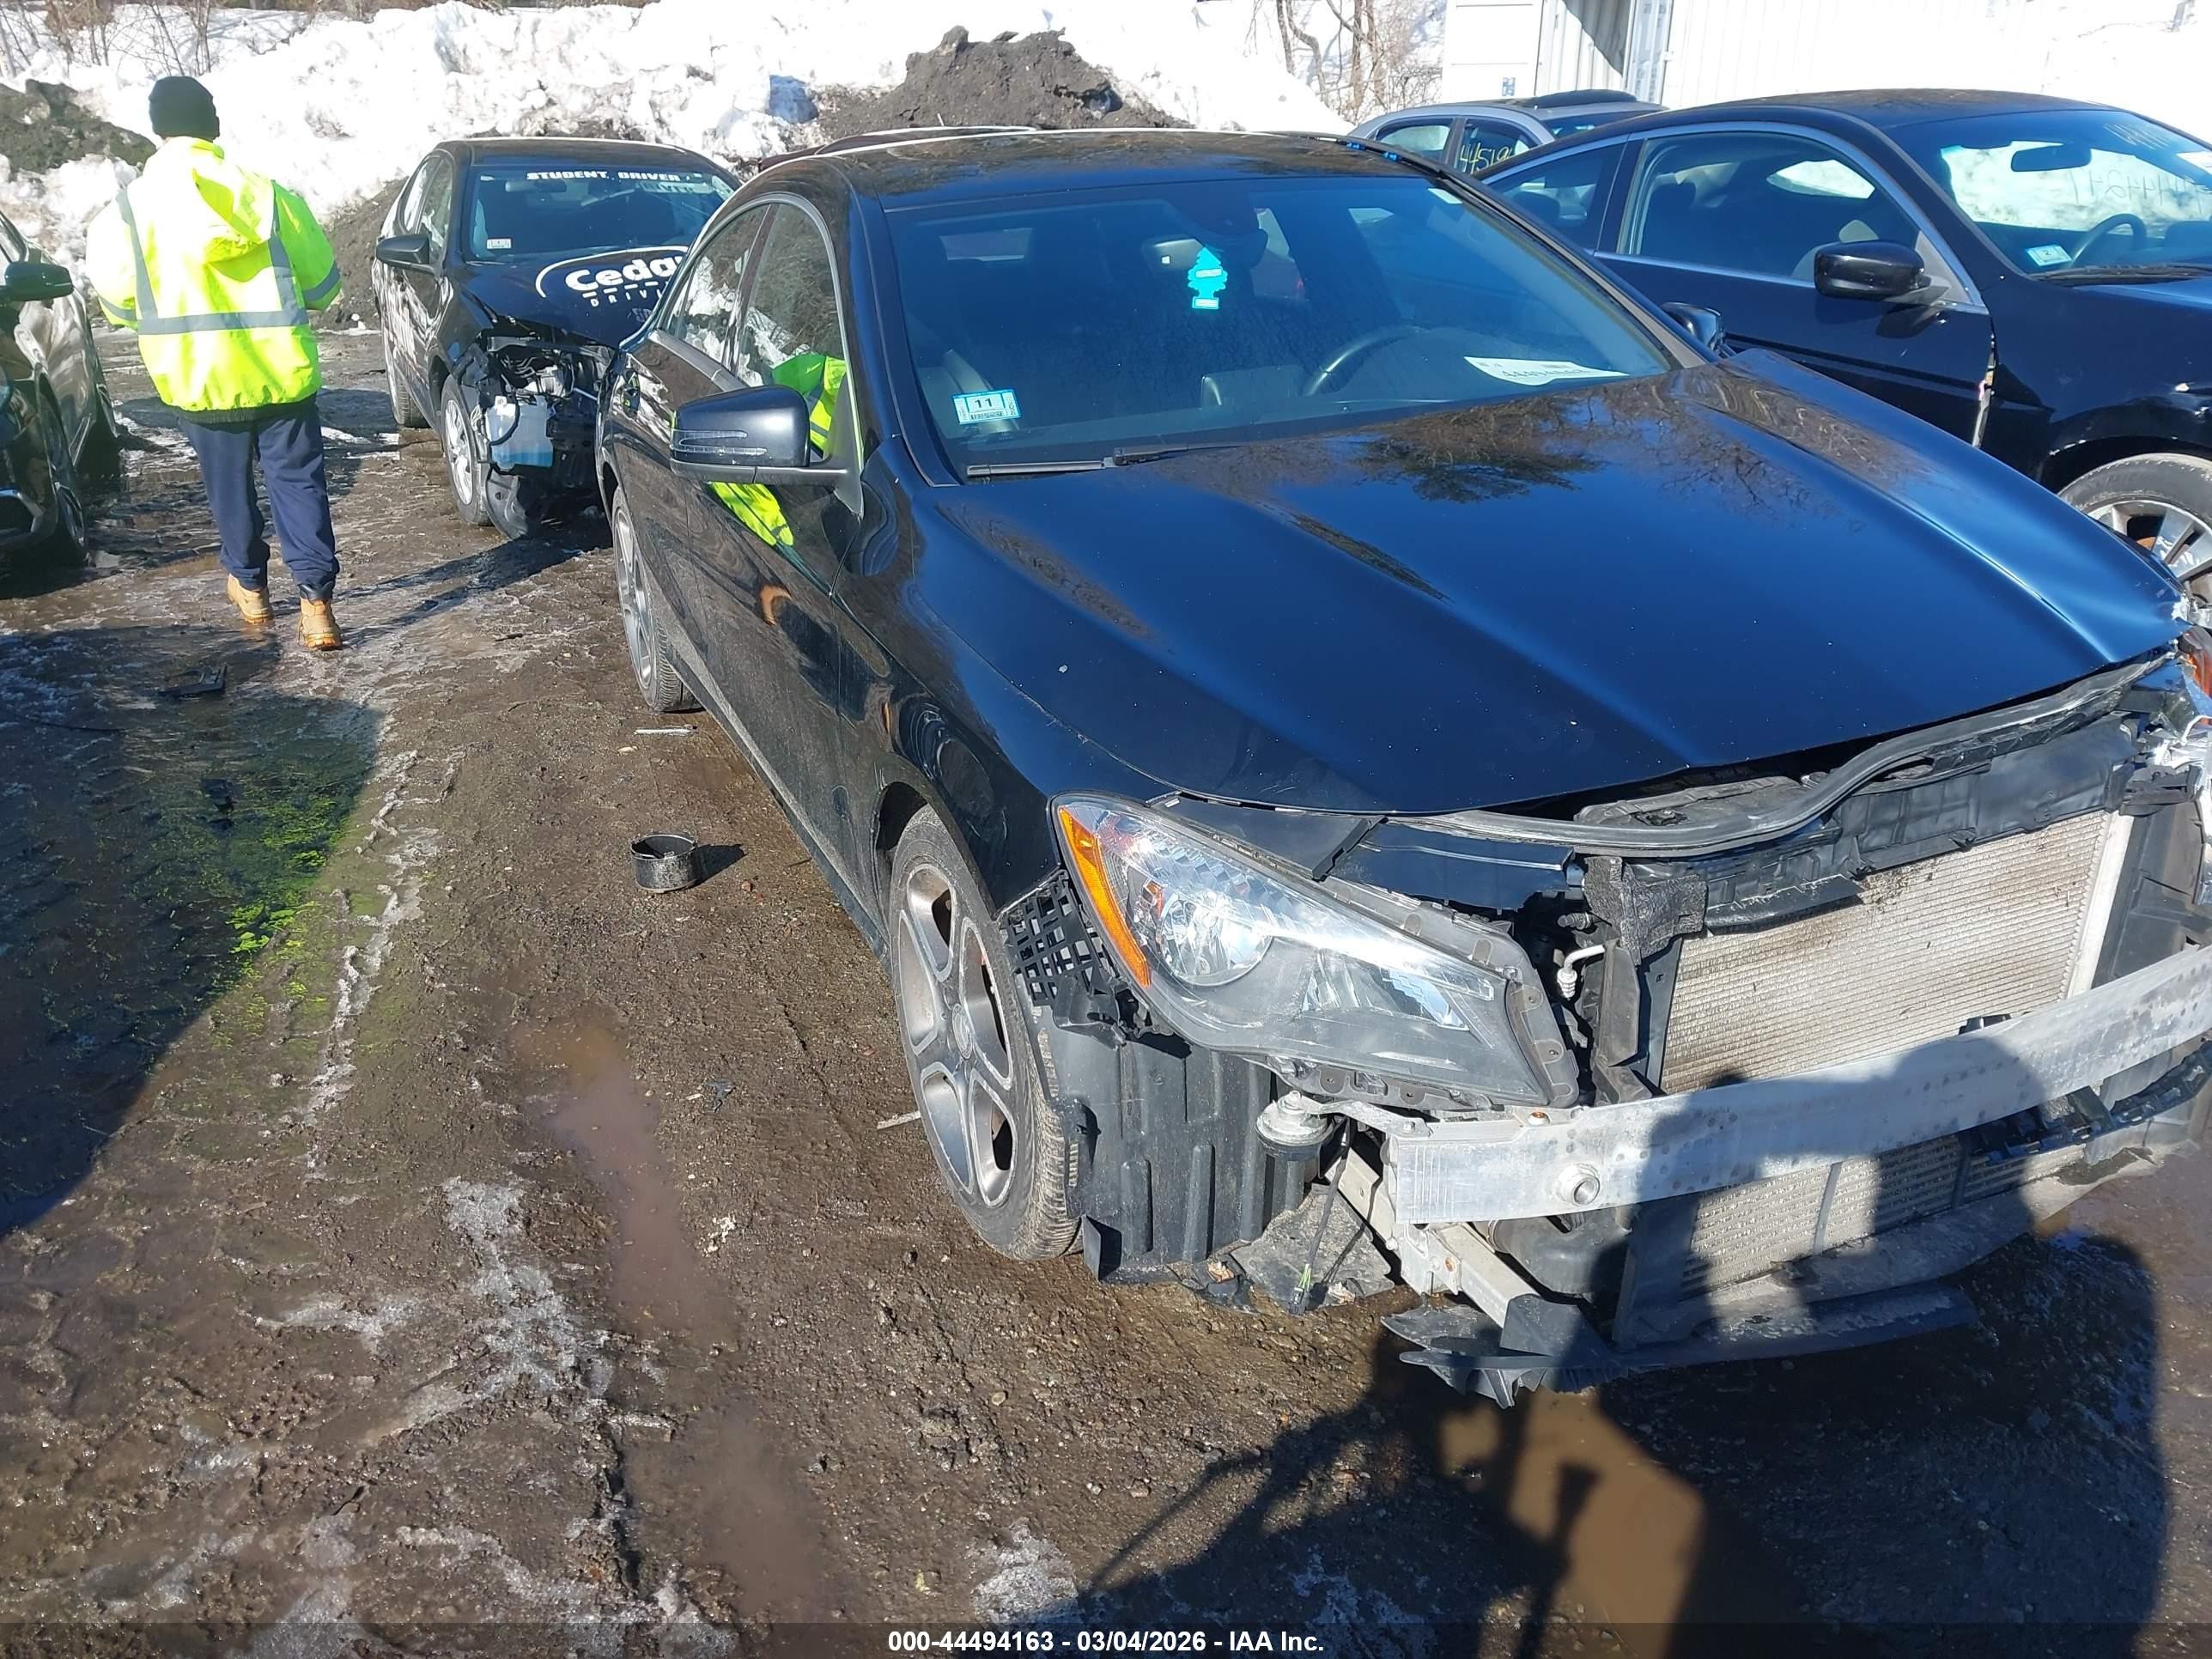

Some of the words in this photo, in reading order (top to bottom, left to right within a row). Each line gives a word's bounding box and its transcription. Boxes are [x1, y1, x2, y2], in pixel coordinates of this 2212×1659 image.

[526, 171, 609, 180] STUDENT
[617, 172, 681, 181] DRIVER
[975, 398, 993, 408] 11
